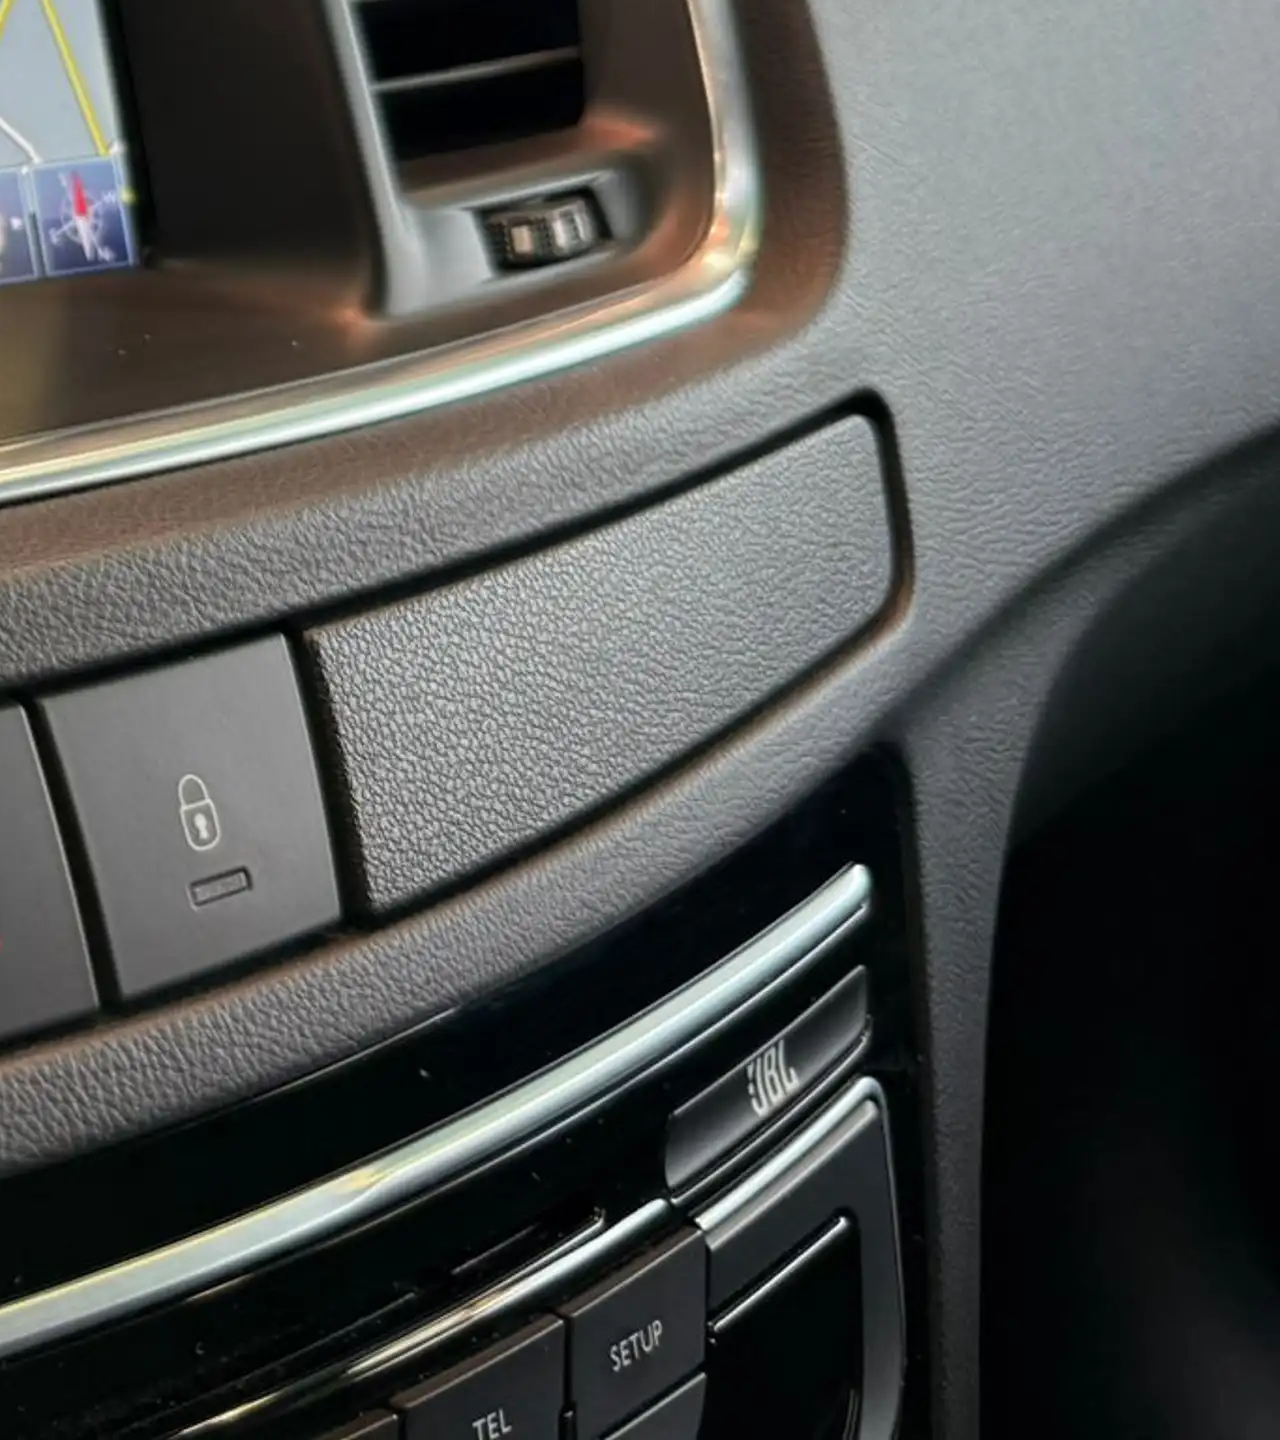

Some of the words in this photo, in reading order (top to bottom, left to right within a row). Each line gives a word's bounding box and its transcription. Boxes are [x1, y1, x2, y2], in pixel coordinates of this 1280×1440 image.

[746, 1039, 801, 1118] JBL
[609, 1319, 664, 1372] SETUP
[472, 1408, 513, 1440] TEL
